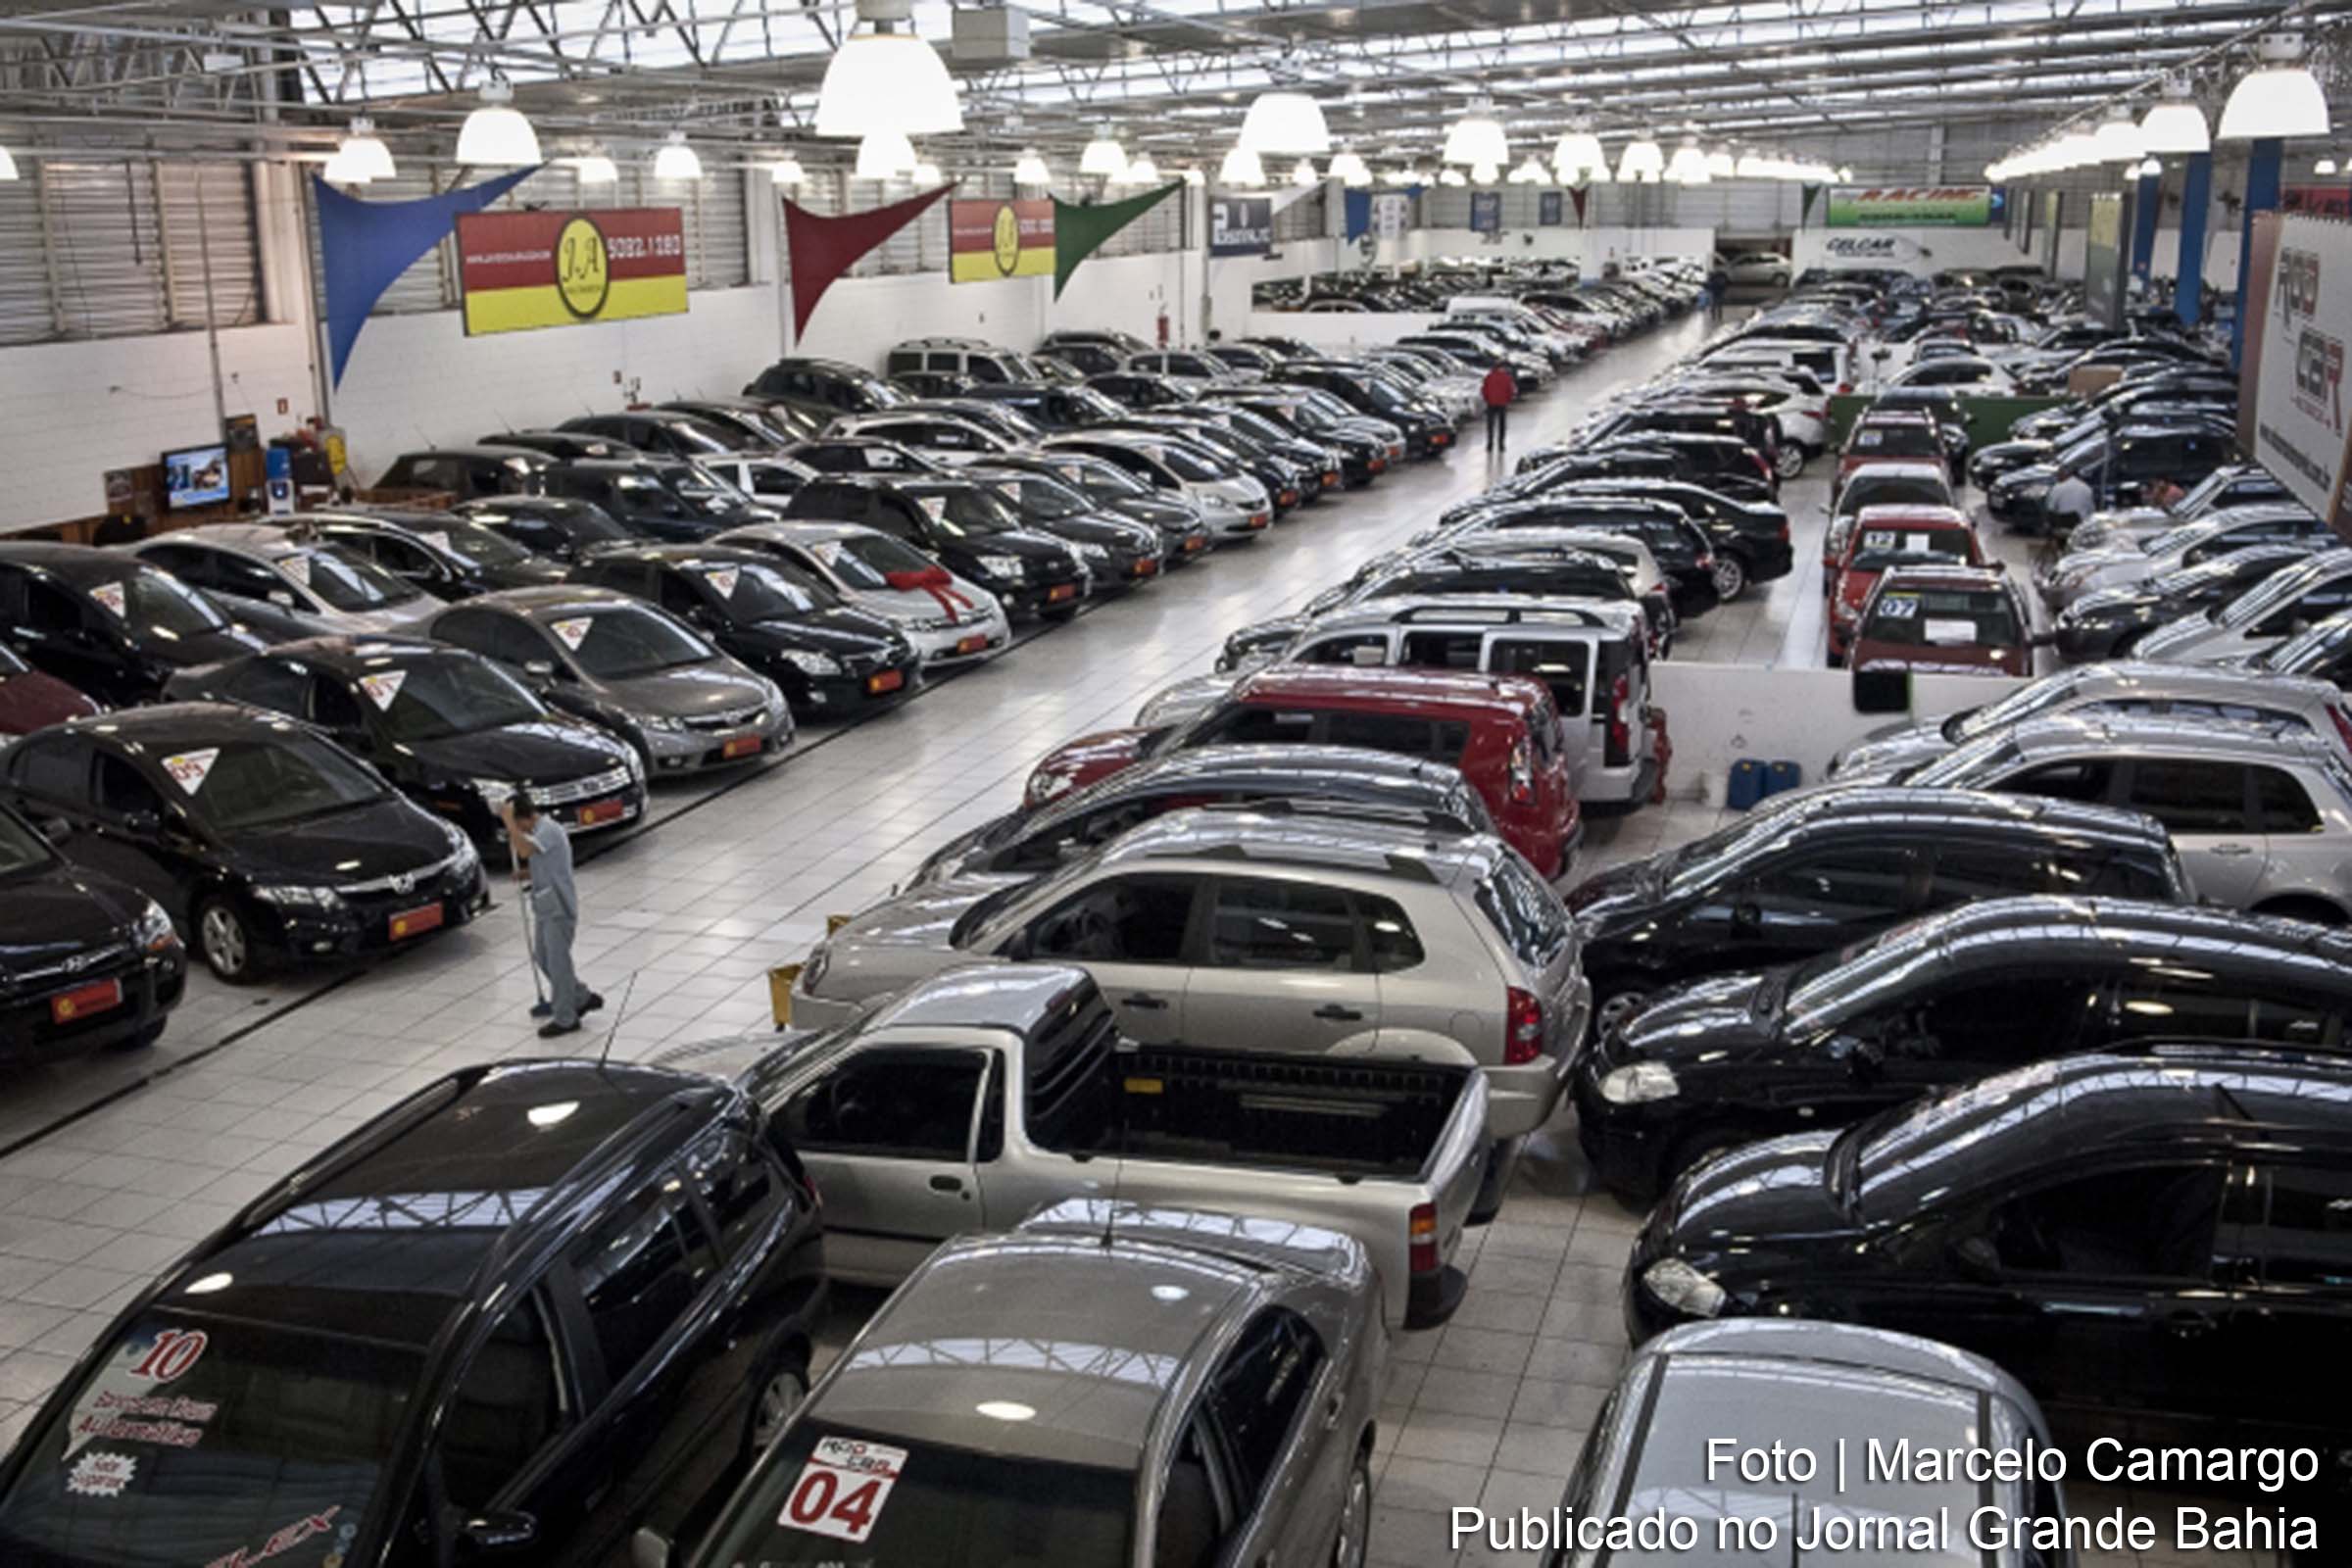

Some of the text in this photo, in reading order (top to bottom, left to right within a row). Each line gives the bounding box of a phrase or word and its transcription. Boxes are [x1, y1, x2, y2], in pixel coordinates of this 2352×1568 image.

[1880, 598, 1913, 616] 07
[128, 1330, 207, 1383] 10
[790, 1471, 882, 1535] 04
